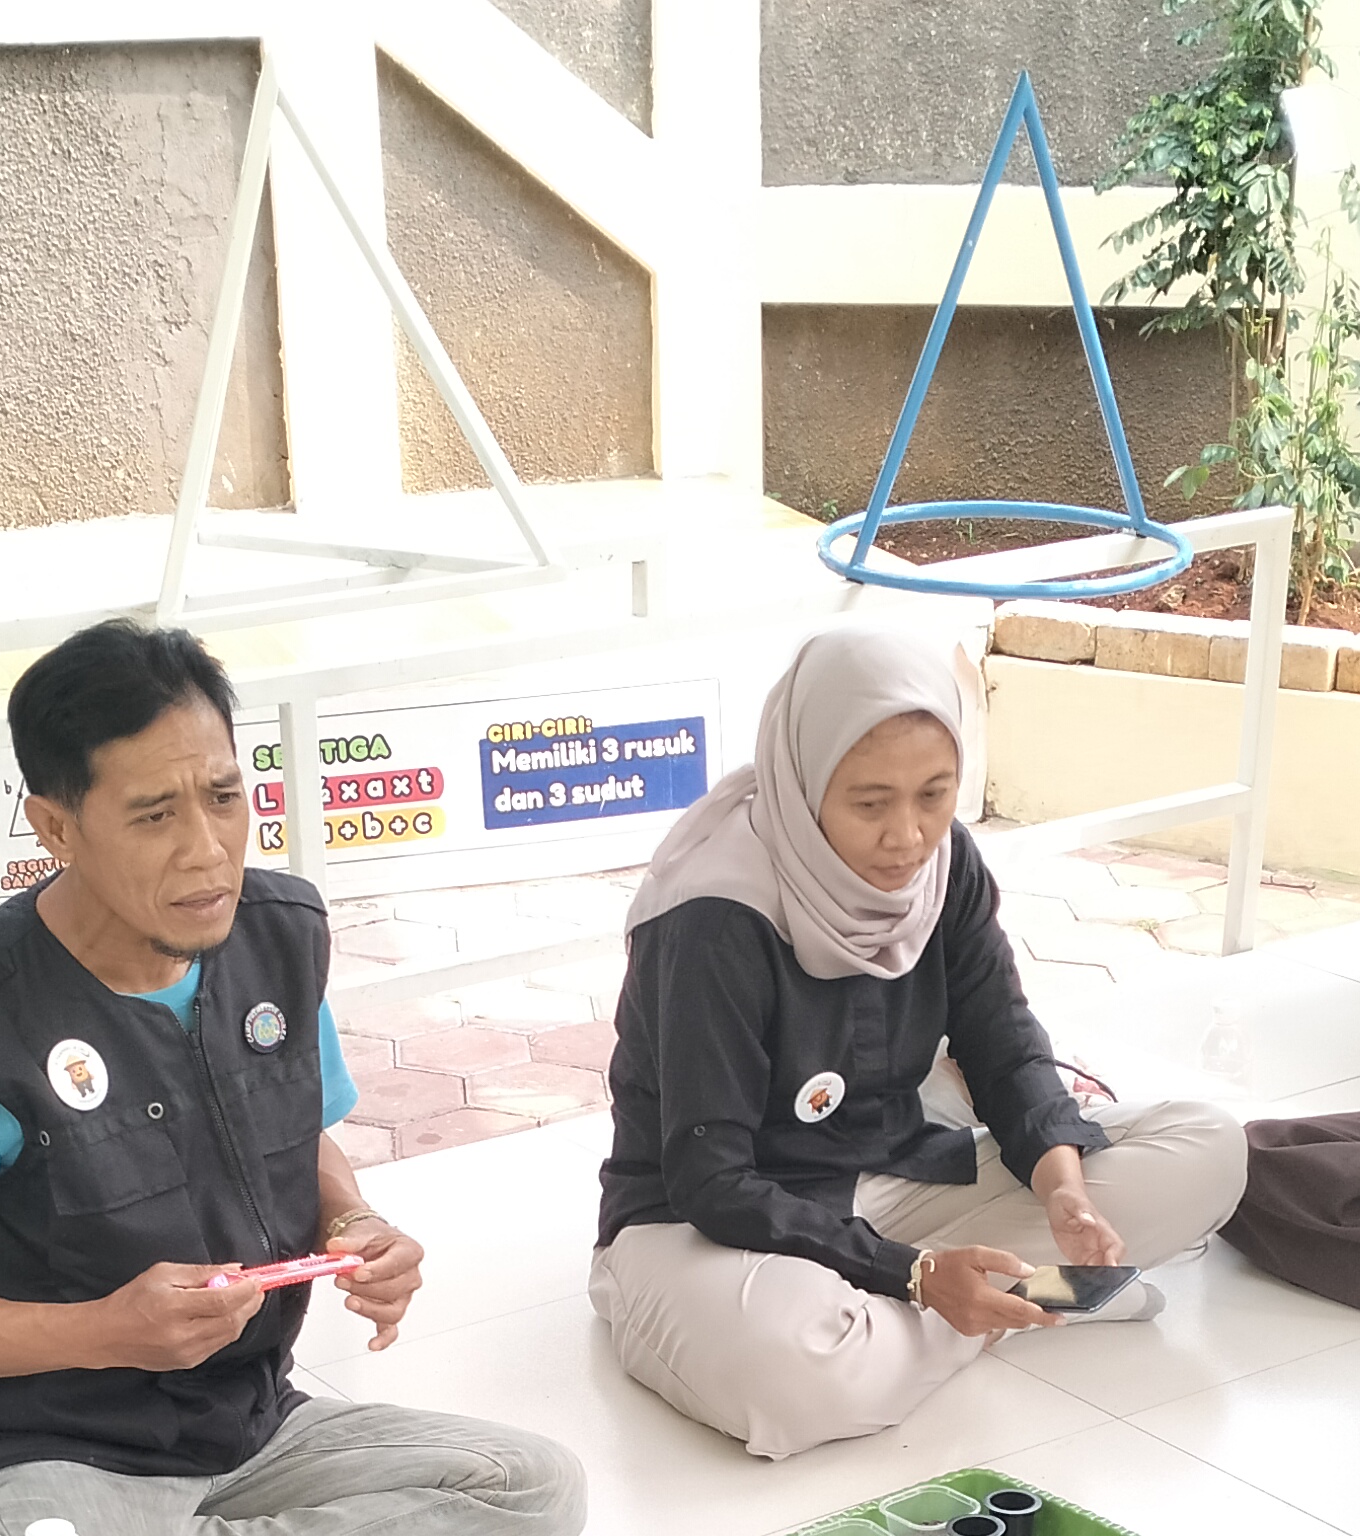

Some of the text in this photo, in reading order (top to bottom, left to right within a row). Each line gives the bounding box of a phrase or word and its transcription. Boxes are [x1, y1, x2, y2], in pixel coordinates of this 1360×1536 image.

[487, 715, 592, 743] CIRI-CIRI:
[253, 733, 392, 771] SETIGA
[491, 728, 696, 774] Memiliki 3 rusuk
[256, 783, 279, 811] L
[494, 774, 645, 813] dan 3 sudut
[259, 821, 284, 850] K
